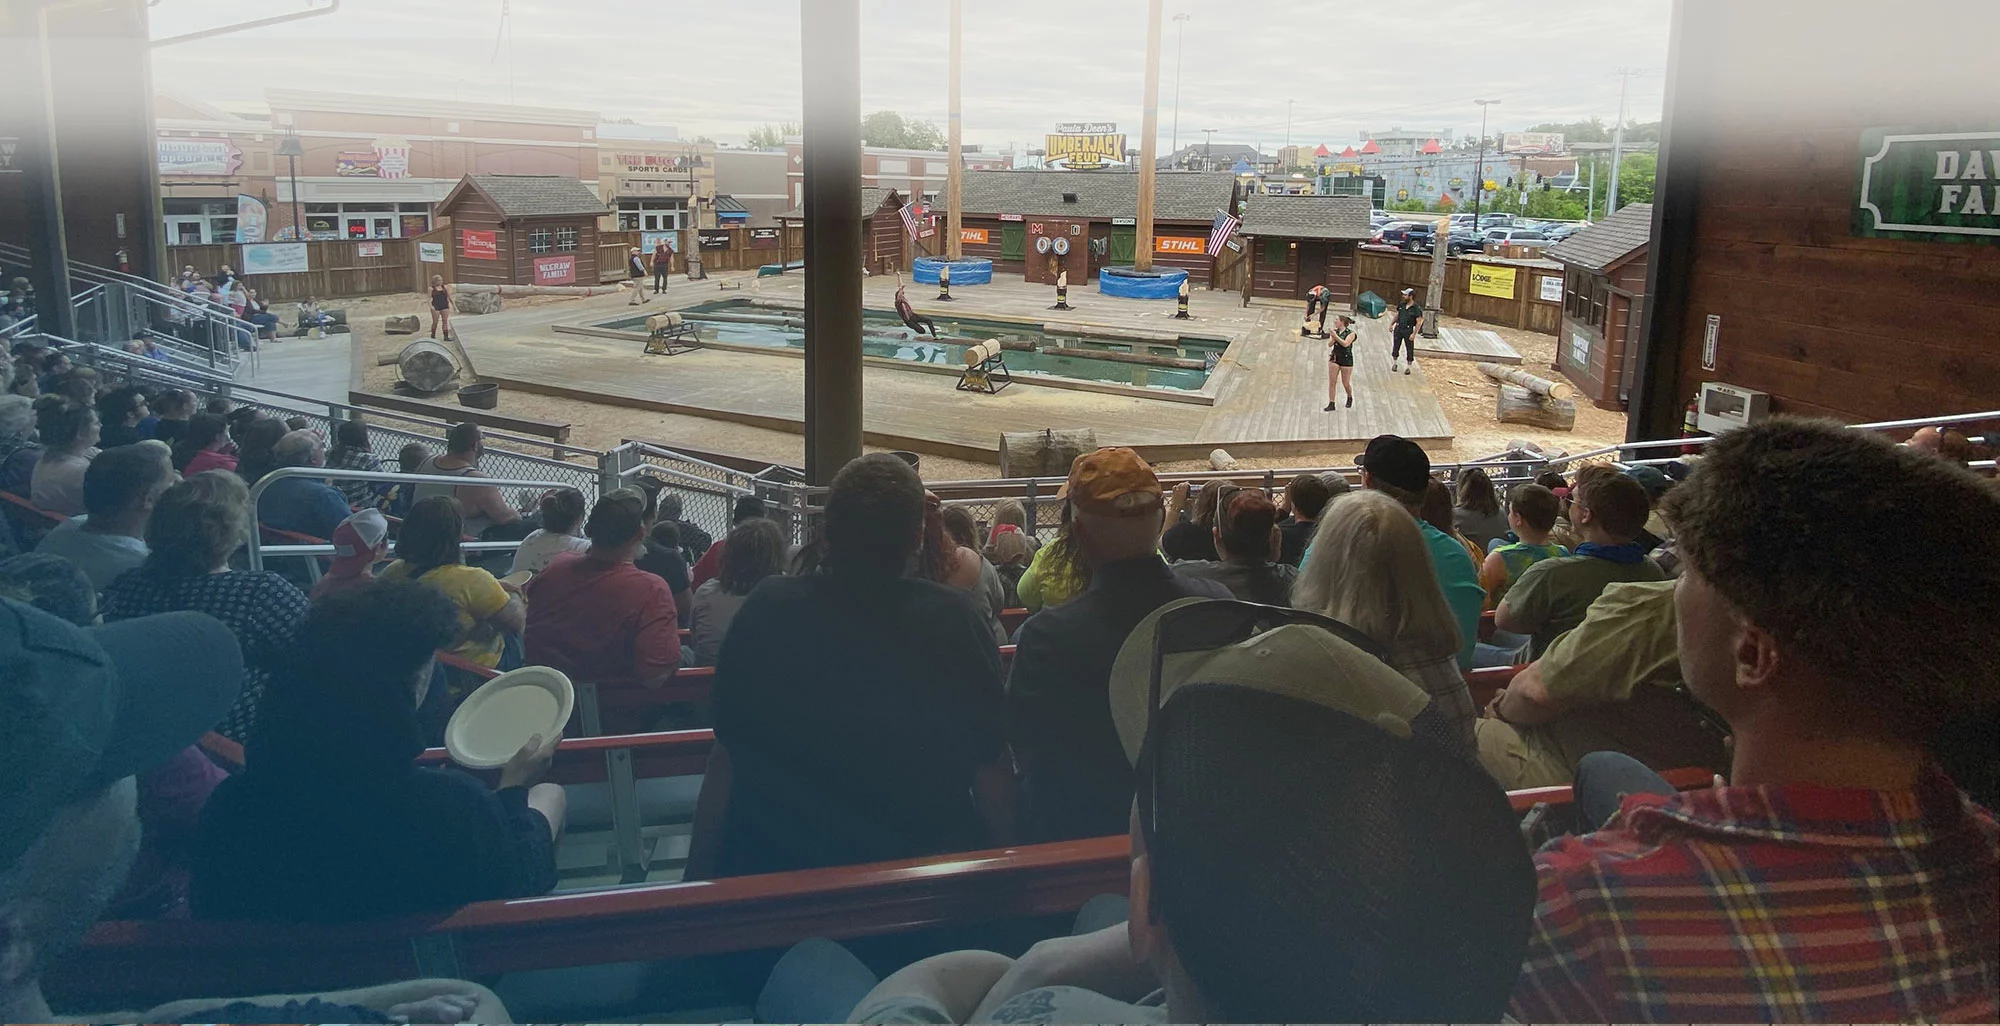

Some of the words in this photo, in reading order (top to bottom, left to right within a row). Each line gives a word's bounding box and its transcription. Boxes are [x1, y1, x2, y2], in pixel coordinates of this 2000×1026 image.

[1046, 133, 1124, 163] LUMBERJACK
[1068, 152, 1099, 162] FEUD
[627, 165, 660, 173] SPORTS
[1031, 222, 1044, 235] M
[960, 231, 984, 241] TIHL
[1160, 240, 1199, 251] STIHL
[543, 269, 568, 279] FAMILY
[1472, 272, 1492, 282] LODGE
